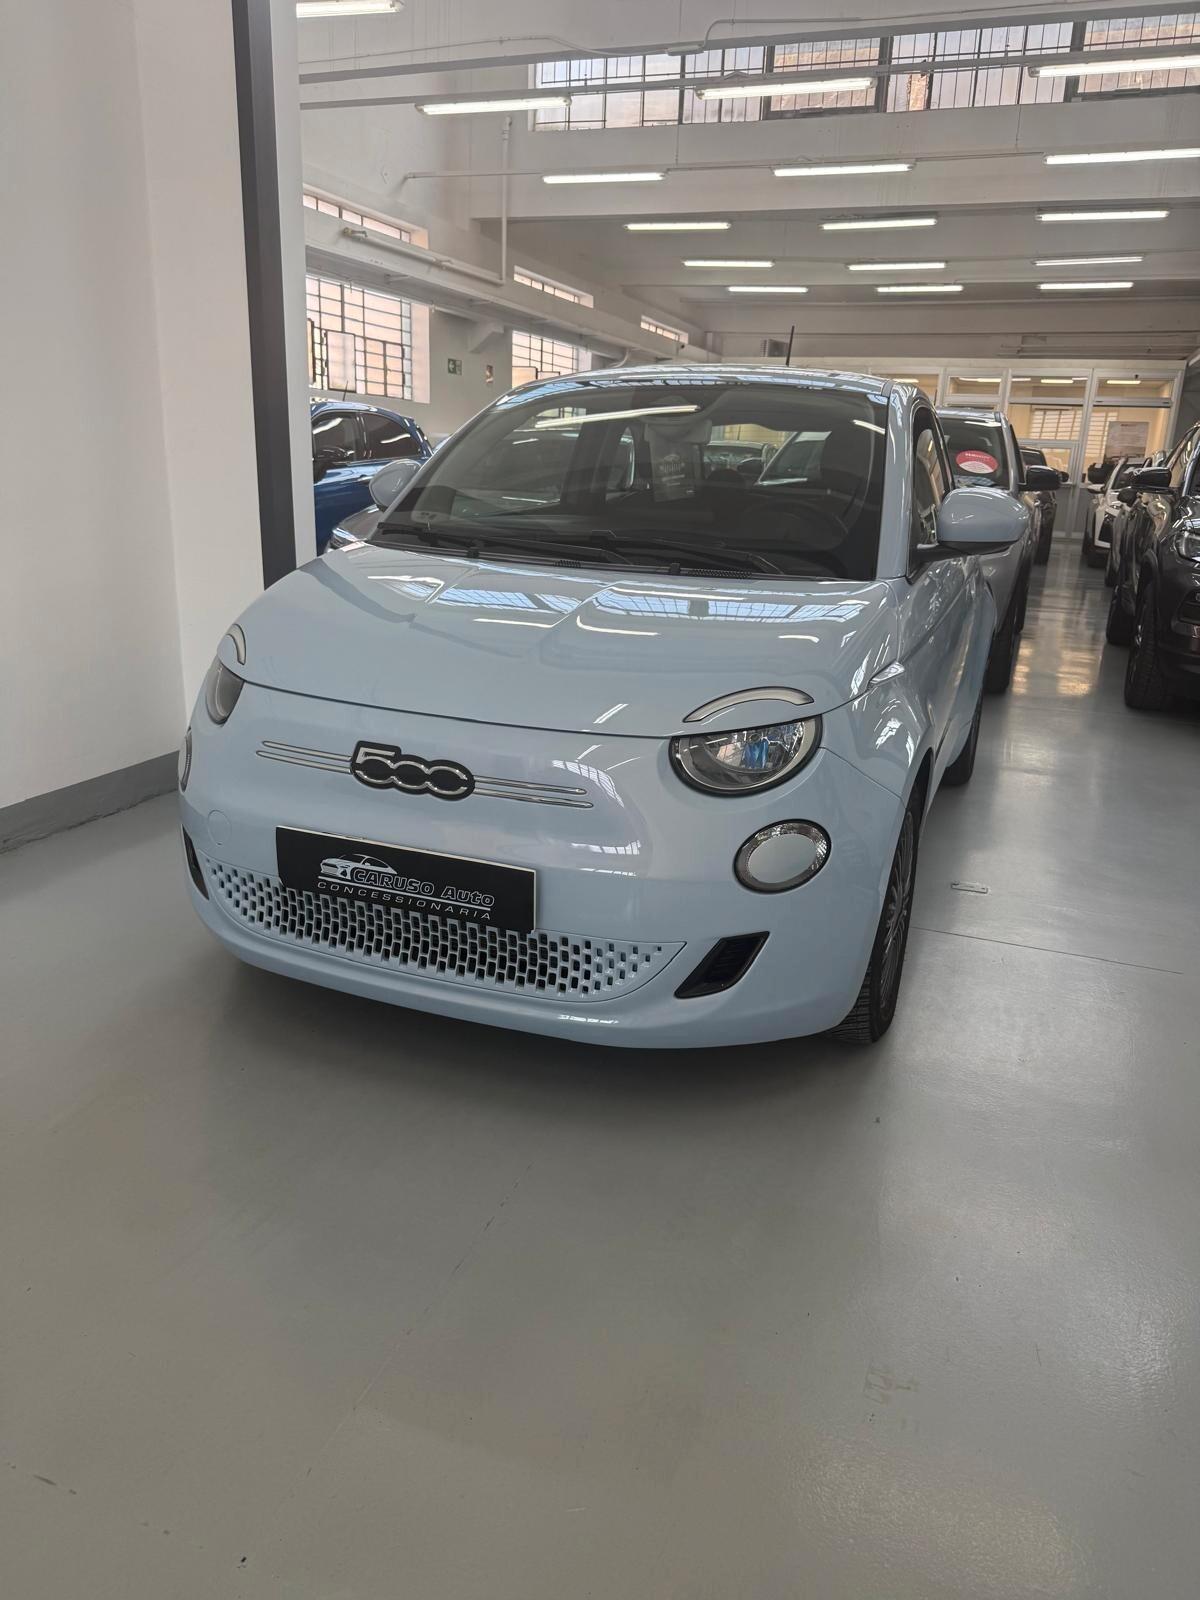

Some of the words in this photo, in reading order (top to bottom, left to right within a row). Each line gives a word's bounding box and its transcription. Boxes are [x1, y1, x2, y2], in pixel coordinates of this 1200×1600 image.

[353, 744, 470, 797] 500
[317, 881, 492, 921] CONCESSIONARIA
[353, 868, 435, 895] CARUSO
